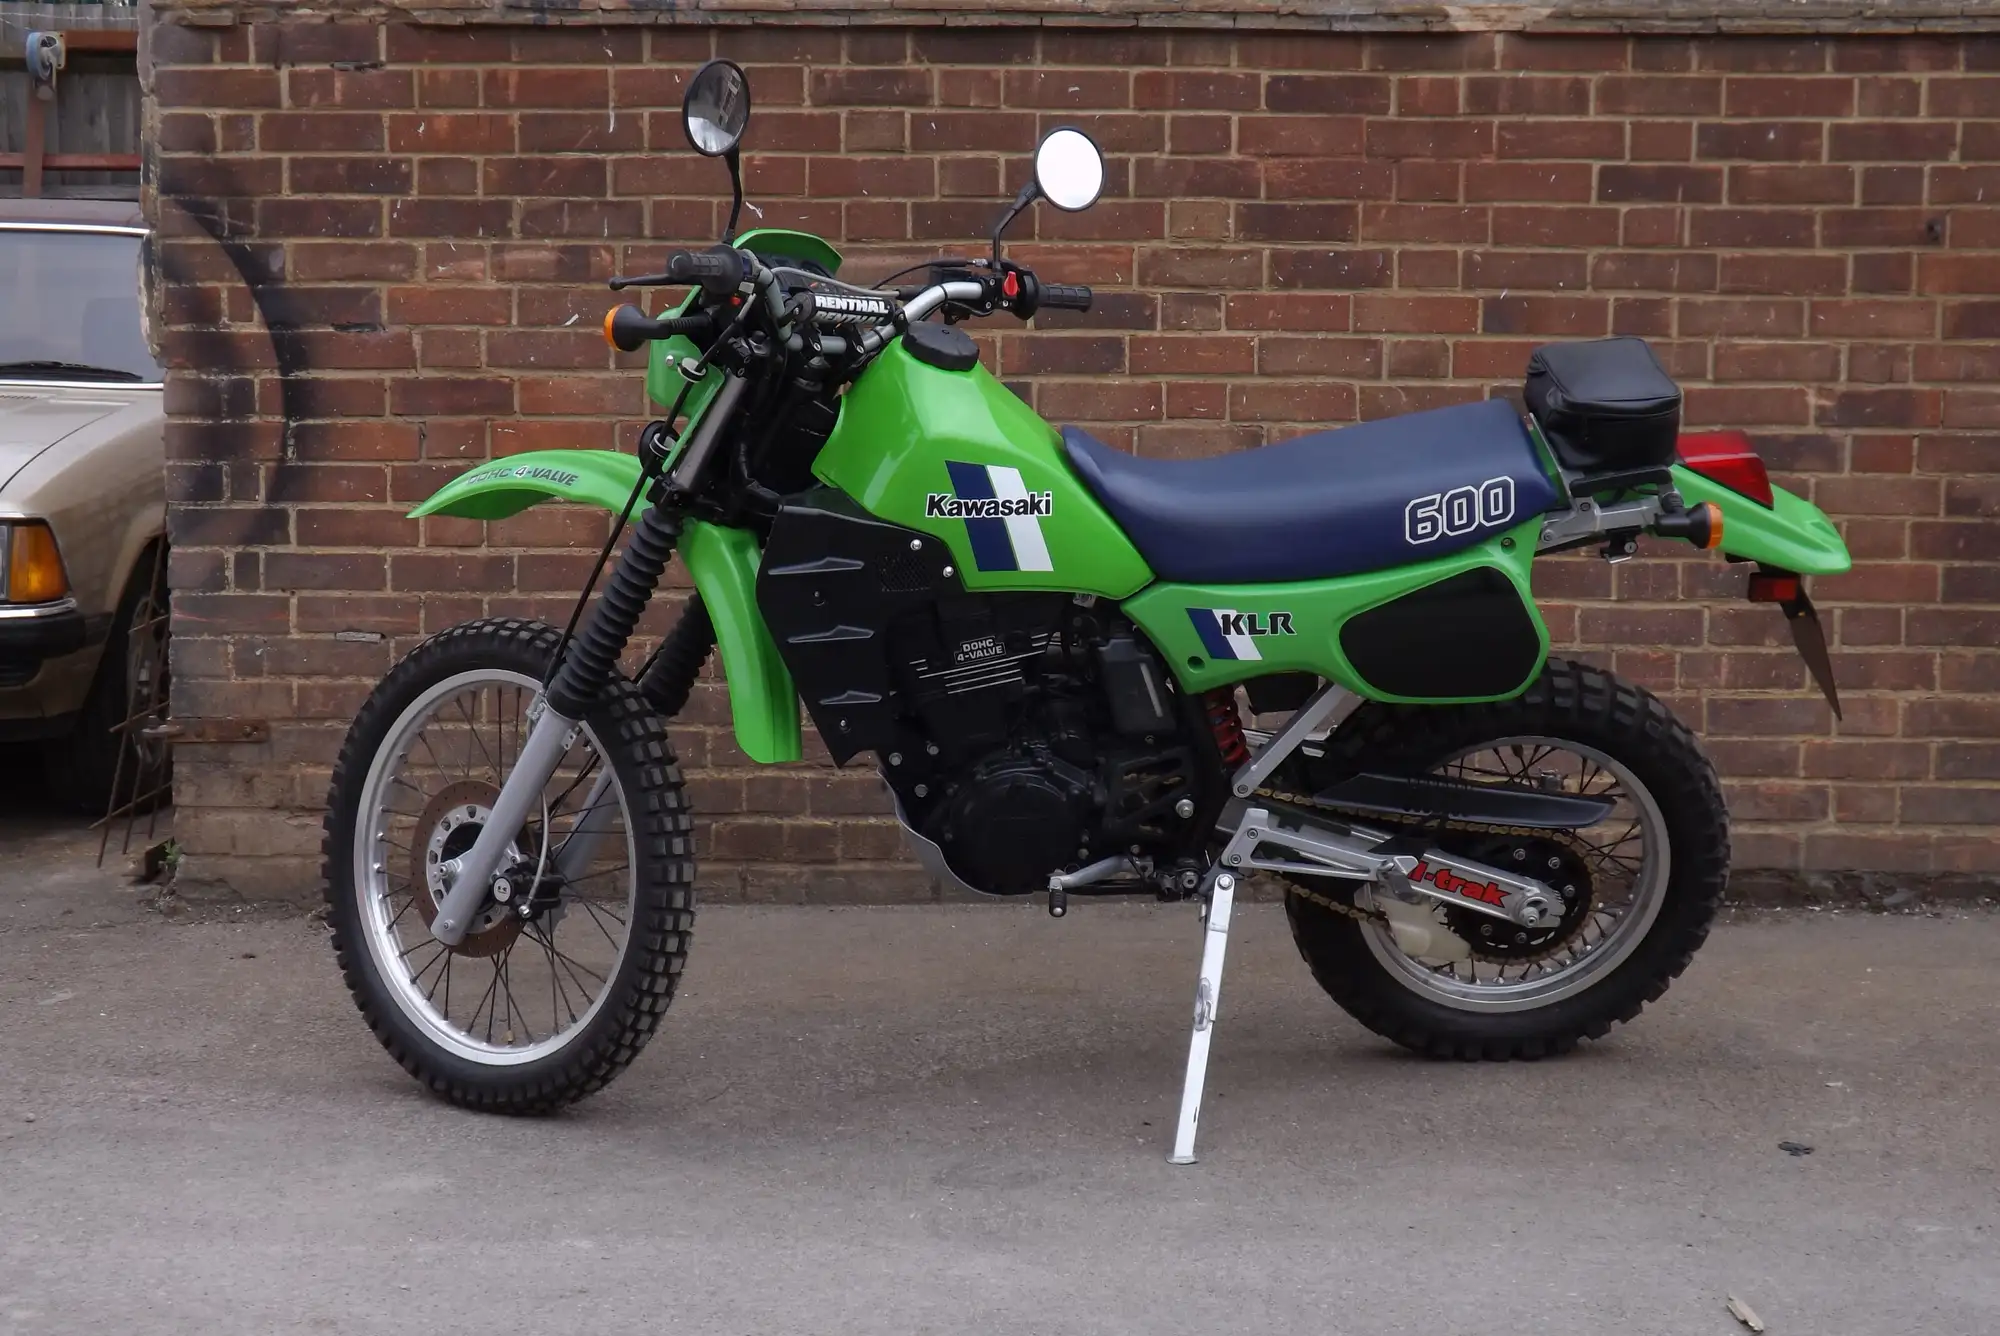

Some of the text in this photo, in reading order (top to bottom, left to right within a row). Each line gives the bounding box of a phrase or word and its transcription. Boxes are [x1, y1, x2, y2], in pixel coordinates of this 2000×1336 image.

[815, 295, 889, 314] RENTHAL
[514, 465, 578, 486] 4-VALVE
[925, 491, 1052, 518] Kawasaki
[1405, 475, 1515, 545] 600
[1220, 611, 1297, 636] KLR
[957, 645, 1003, 661] 4-VALVE
[962, 638, 994, 652] DOHC
